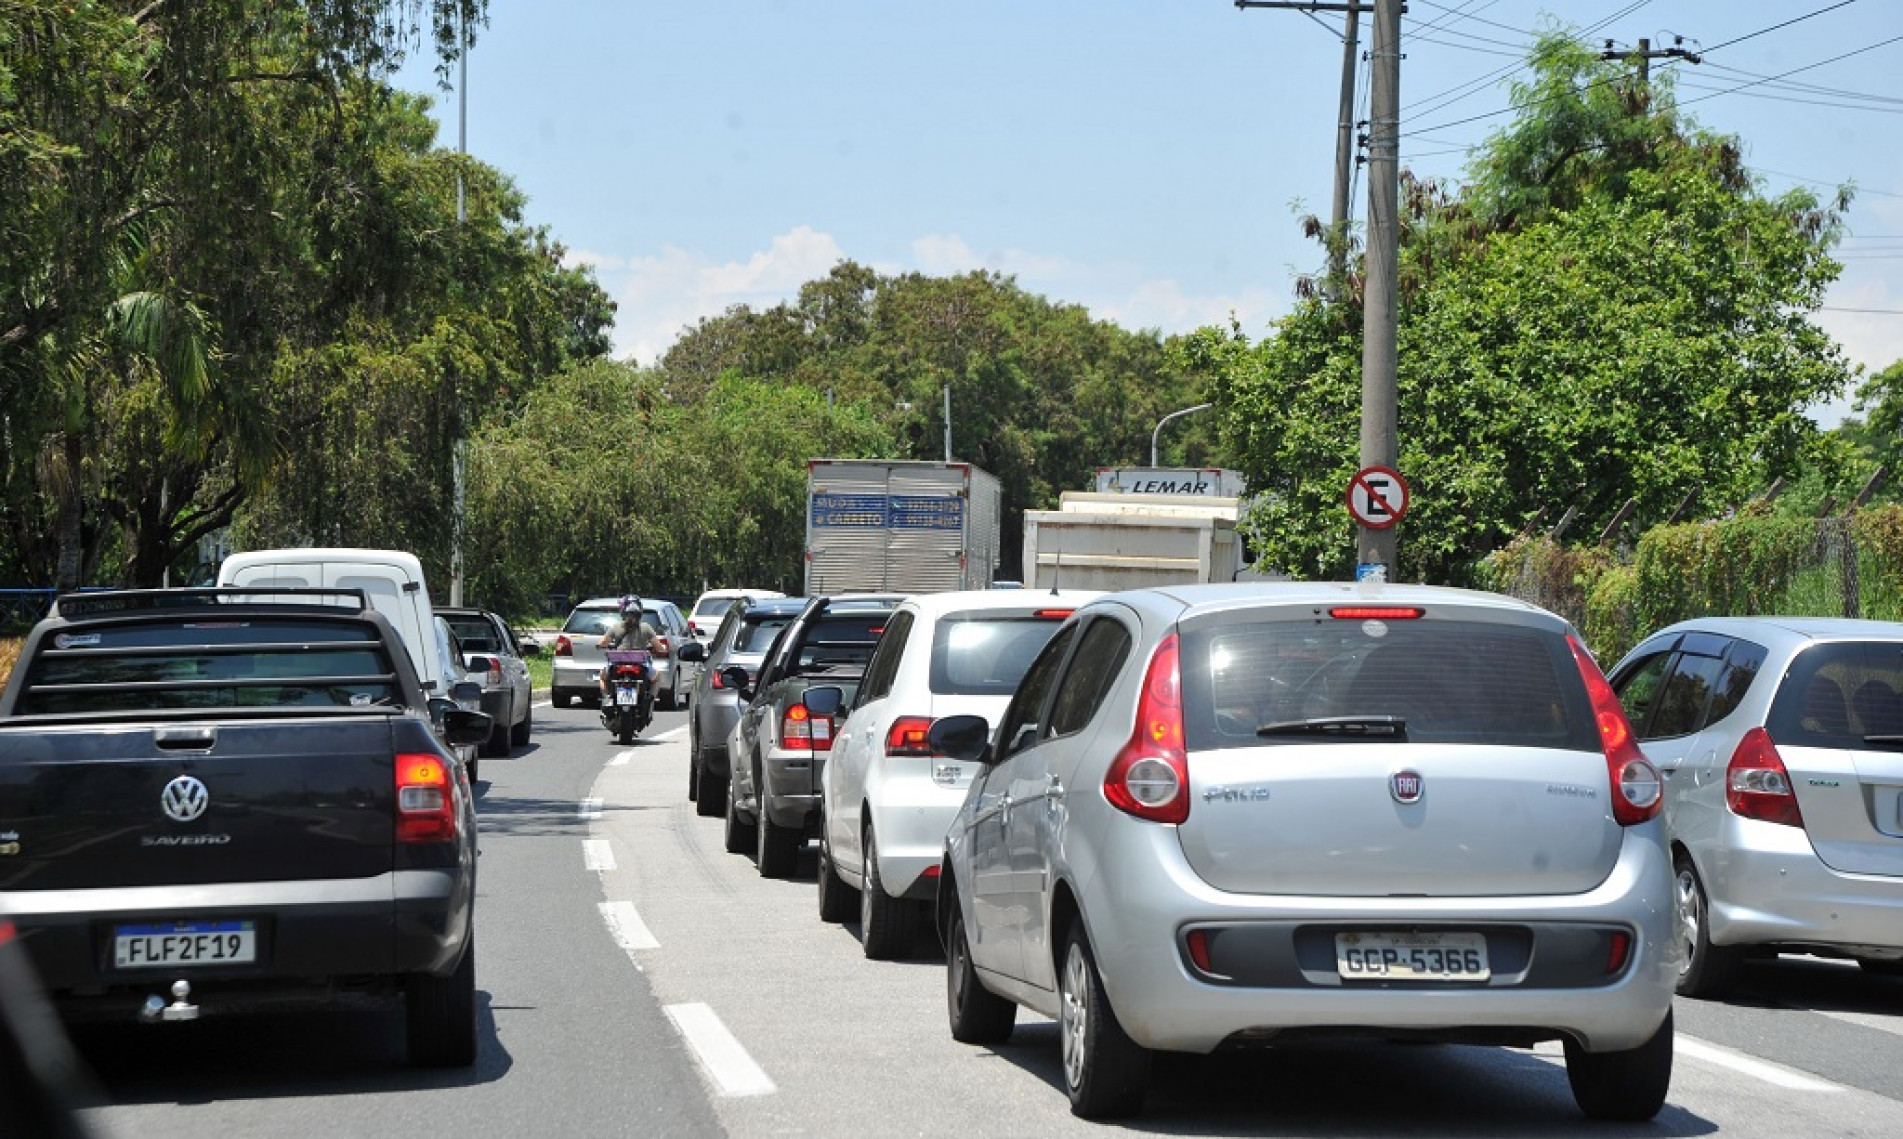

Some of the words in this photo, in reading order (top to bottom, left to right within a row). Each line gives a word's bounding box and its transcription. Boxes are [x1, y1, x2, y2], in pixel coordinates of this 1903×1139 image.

[1132, 480, 1210, 495] LEMAR
[1367, 481, 1389, 515] E
[129, 934, 241, 962] FLF2F19
